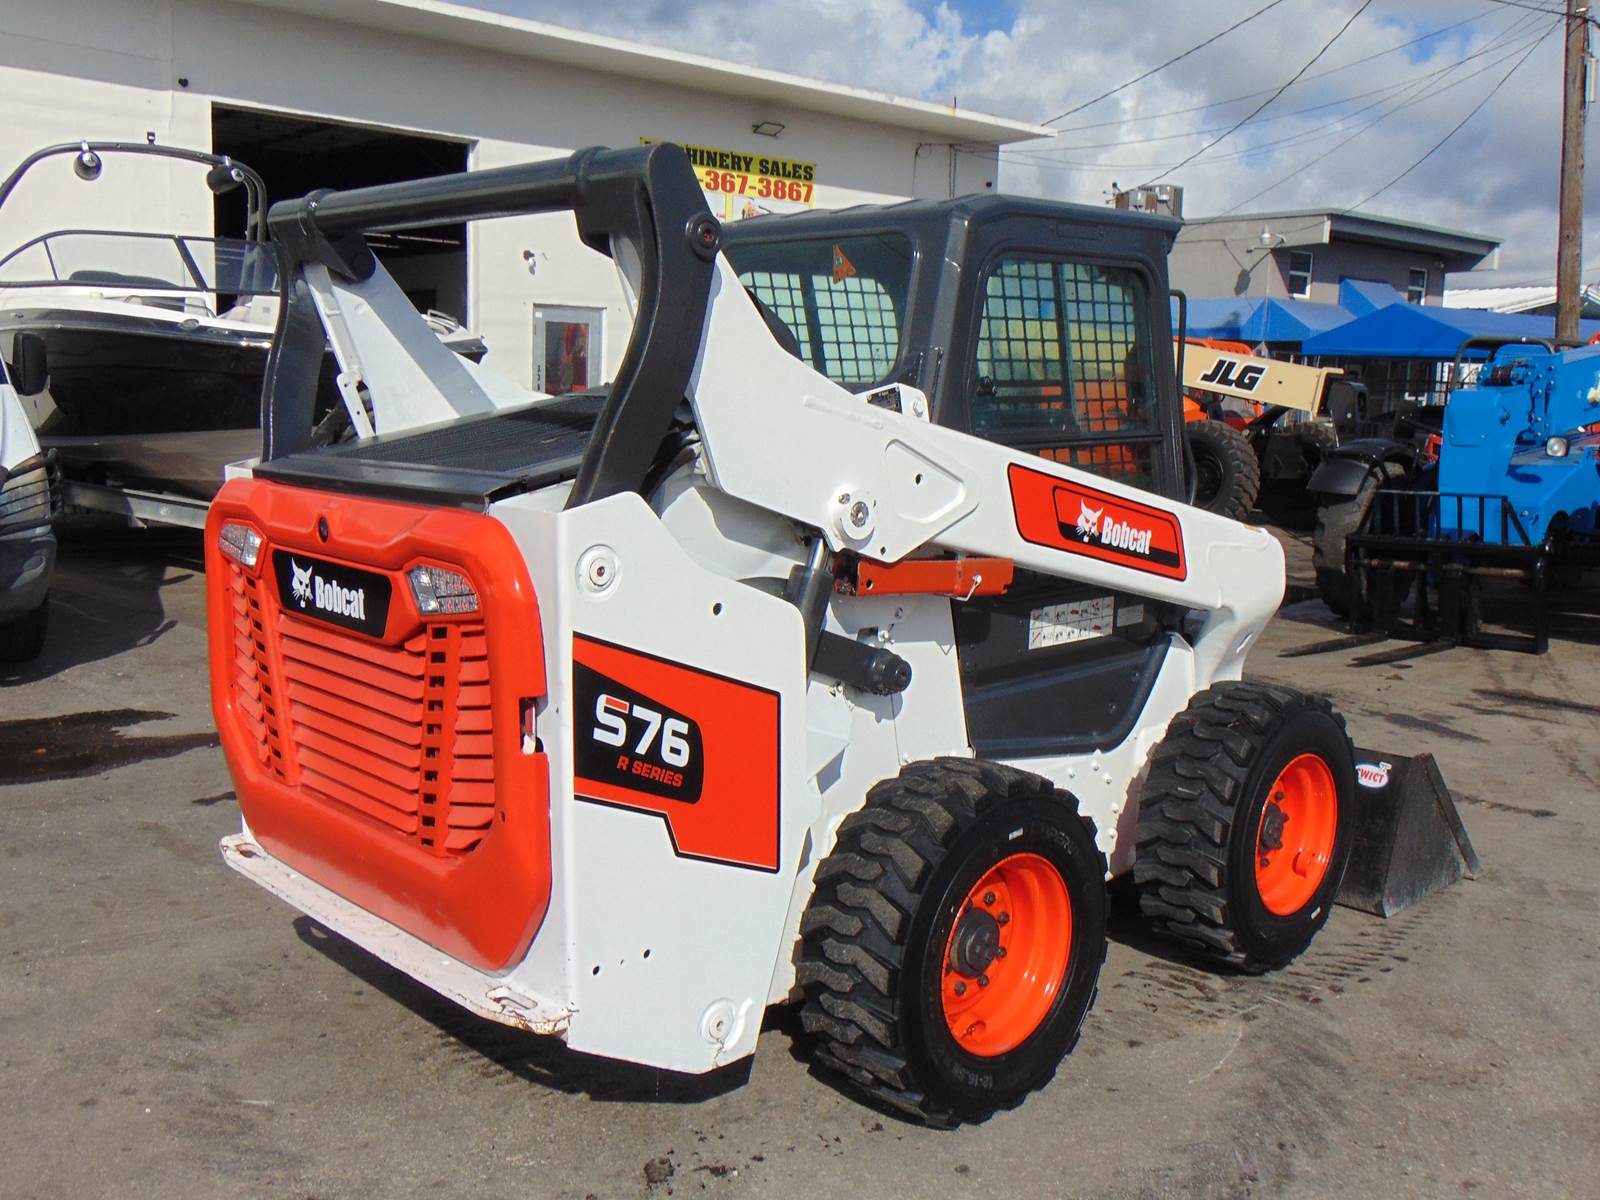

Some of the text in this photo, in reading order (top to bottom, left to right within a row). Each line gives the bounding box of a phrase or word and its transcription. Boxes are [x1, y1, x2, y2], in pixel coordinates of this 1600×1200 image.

[685, 147, 813, 181] HINERY SALES
[700, 169, 813, 203] -367-3867
[1200, 359, 1266, 391] JLG
[1101, 516, 1152, 555] Bobcat
[314, 575, 366, 621] Bobcat
[593, 693, 690, 768] S76
[616, 755, 684, 788] R SERIES
[1357, 767, 1384, 783] WICT
